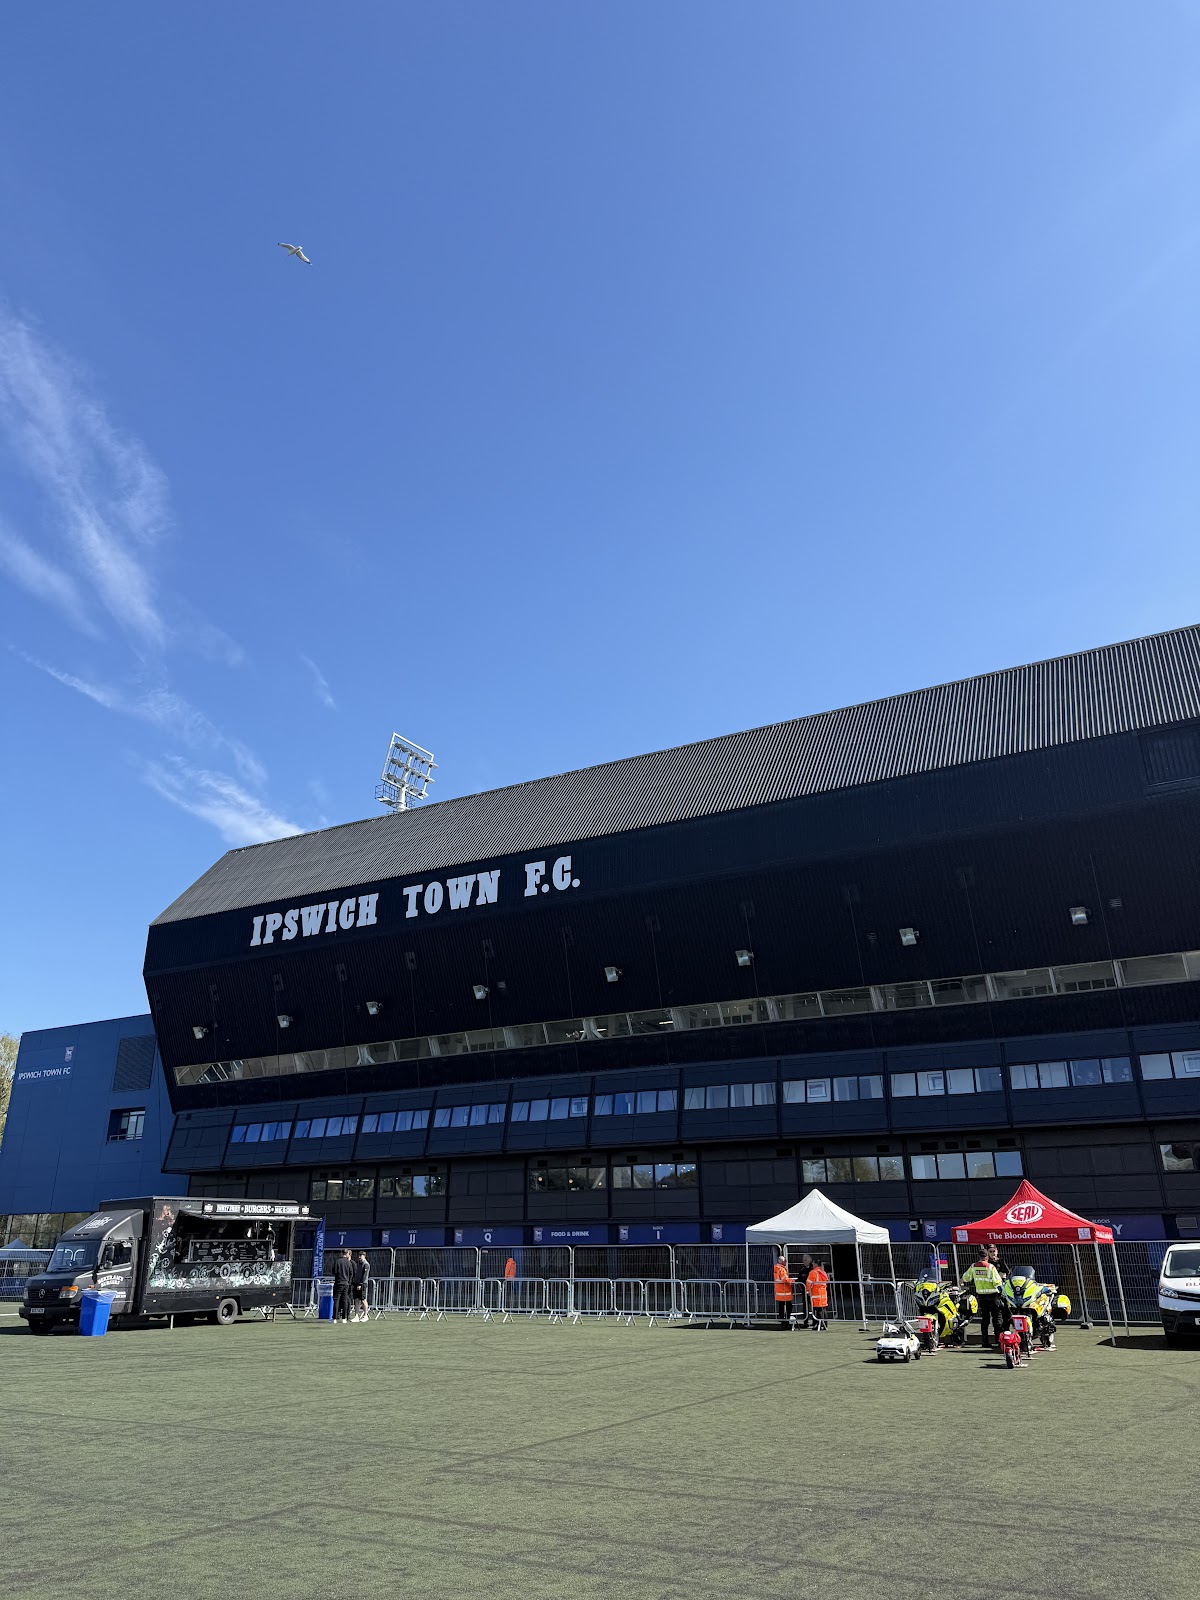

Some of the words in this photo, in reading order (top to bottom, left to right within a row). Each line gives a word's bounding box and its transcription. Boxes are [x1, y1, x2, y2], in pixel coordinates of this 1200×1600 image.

[250, 893, 379, 946] IPSWICH
[403, 869, 500, 918] TOWN
[524, 856, 581, 897] F.C.
[18, 1071, 41, 1080] IPSWICH
[43, 1068, 62, 1077] TOWN
[63, 1067, 71, 1075] FC
[244, 1204, 271, 1214] BURGERS
[1112, 1224, 1123, 1235] Y
[340, 1235, 344, 1245] J
[408, 1233, 416, 1244] JJ
[484, 1233, 492, 1242] Q
[987, 1232, 1002, 1240] The
[1004, 1231, 1058, 1240] Bloodrunners
